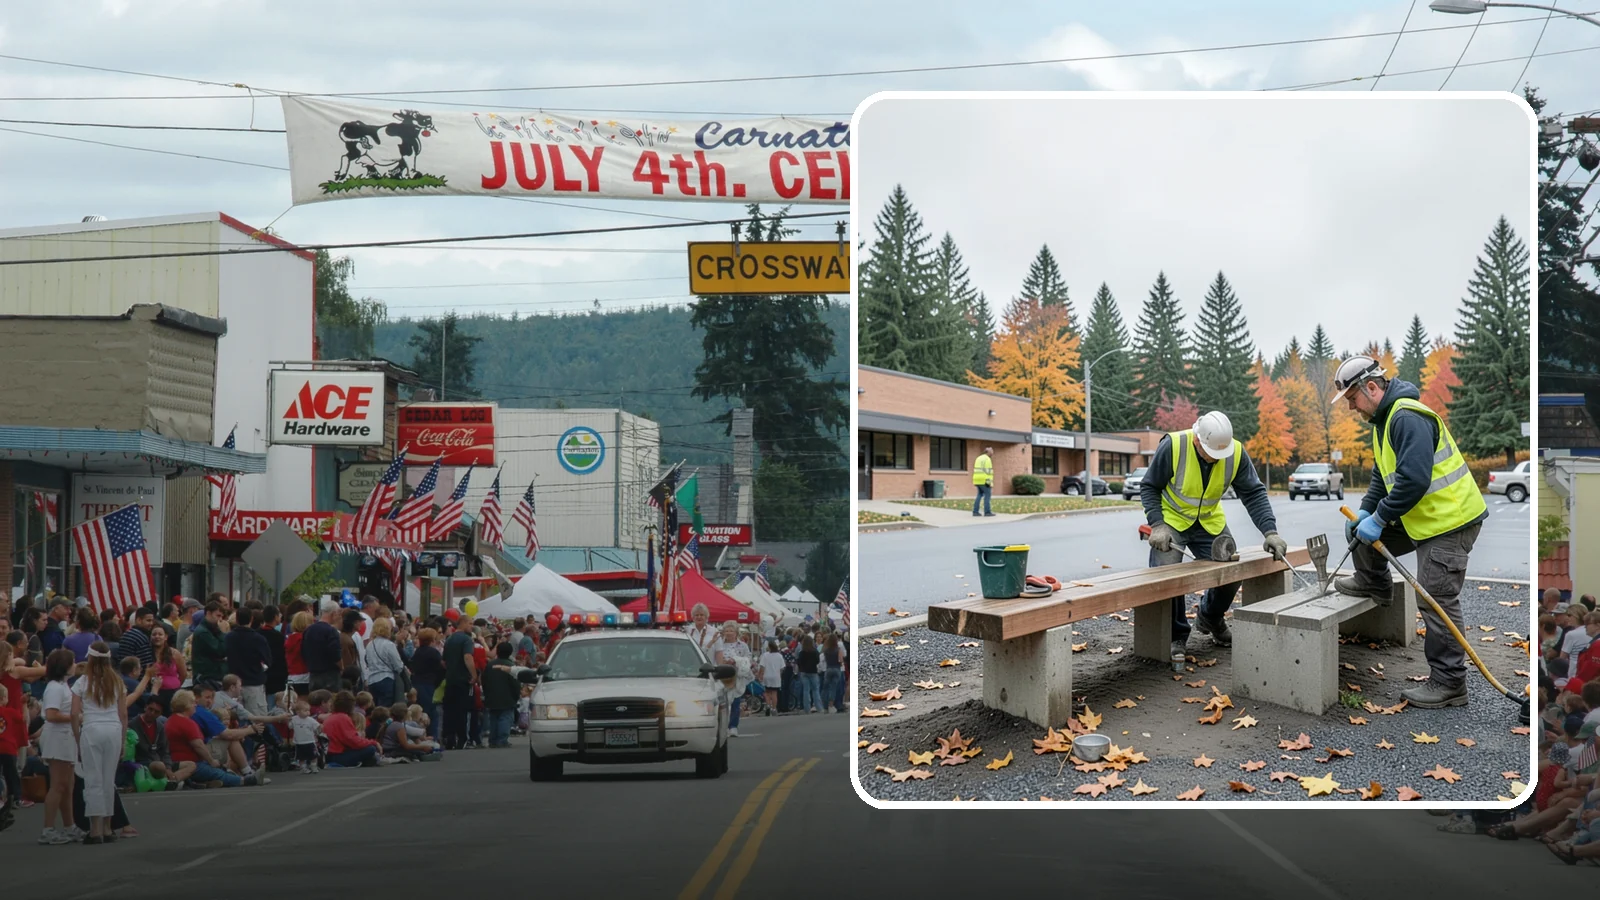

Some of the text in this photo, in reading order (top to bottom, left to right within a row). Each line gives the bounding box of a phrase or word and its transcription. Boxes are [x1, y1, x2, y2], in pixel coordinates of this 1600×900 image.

[695, 121, 850, 149] Carnat
[481, 141, 605, 193] JULY
[632, 150, 746, 198] 4th.
[697, 254, 850, 280] CROSSWA
[282, 380, 373, 419] ACE
[406, 410, 452, 422] CEDAR
[283, 421, 371, 436] Hardware
[416, 428, 477, 447] Coca-Cola
[95, 485, 124, 495] Vincent
[126, 486, 136, 495] de
[137, 486, 155, 495] Paul
[688, 526, 742, 535] CRNATION
[699, 535, 730, 543] GLASS
